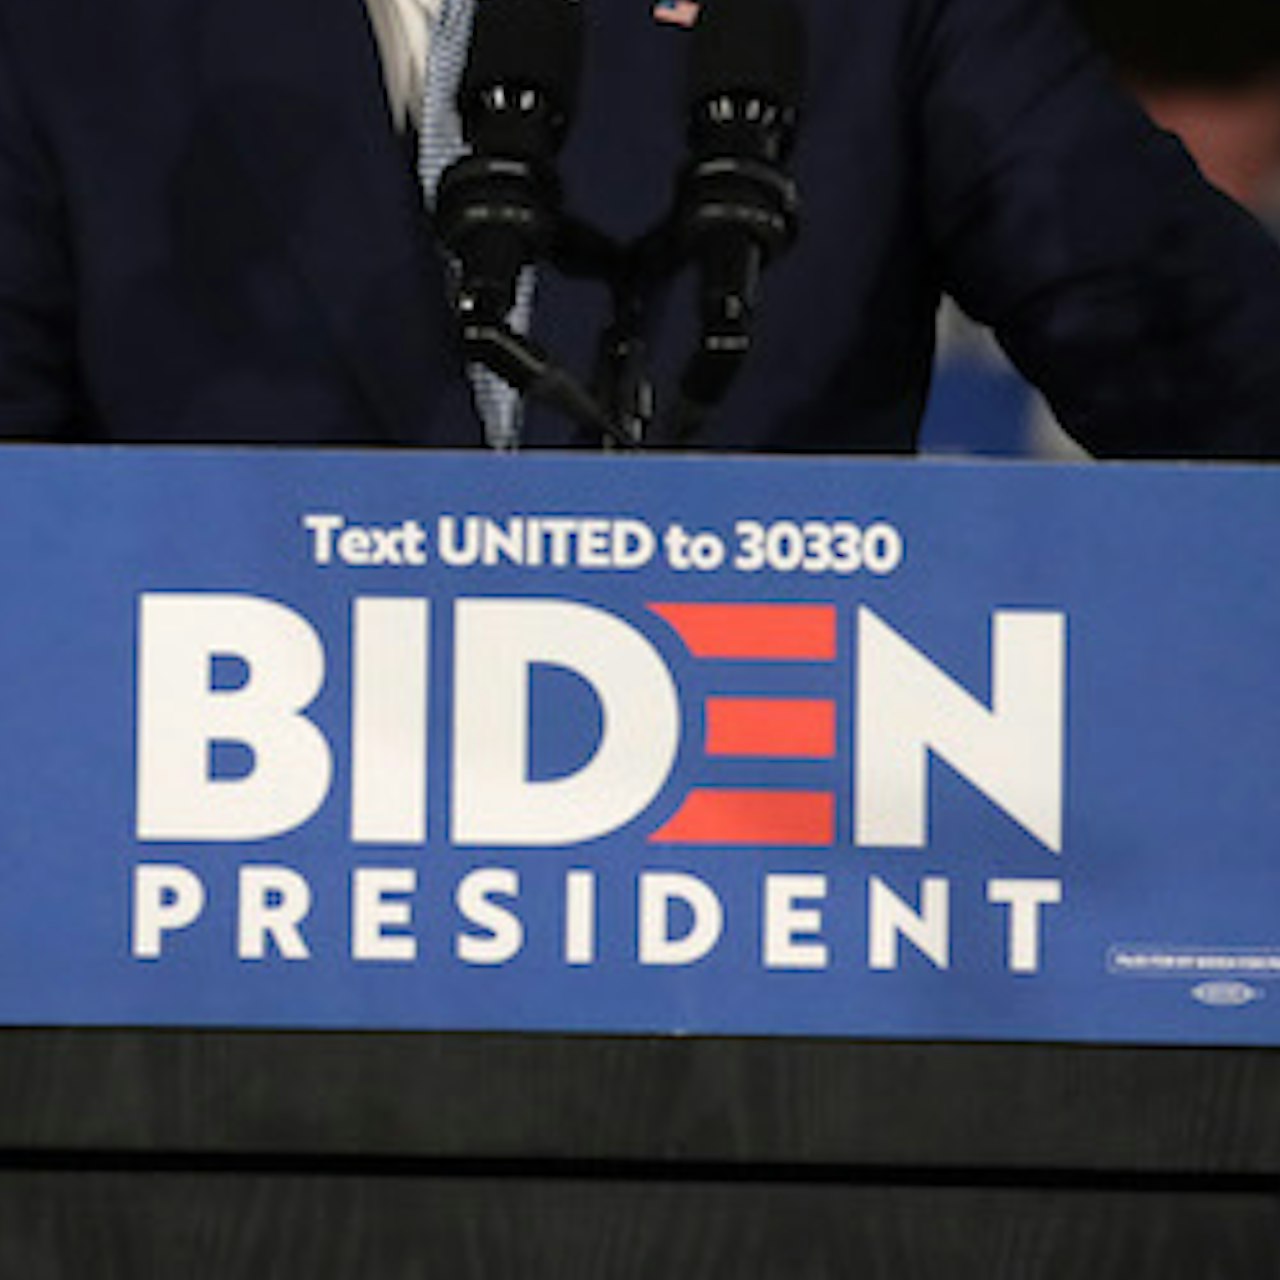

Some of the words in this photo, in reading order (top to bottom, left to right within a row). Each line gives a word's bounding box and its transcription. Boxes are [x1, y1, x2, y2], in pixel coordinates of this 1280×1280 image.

[304, 515, 426, 566] Text
[439, 517, 656, 568] UNITED
[664, 524, 725, 572] to
[733, 520, 904, 574] 30330
[135, 592, 1068, 854] BIDEN
[132, 863, 1062, 974] PRESIDENT
